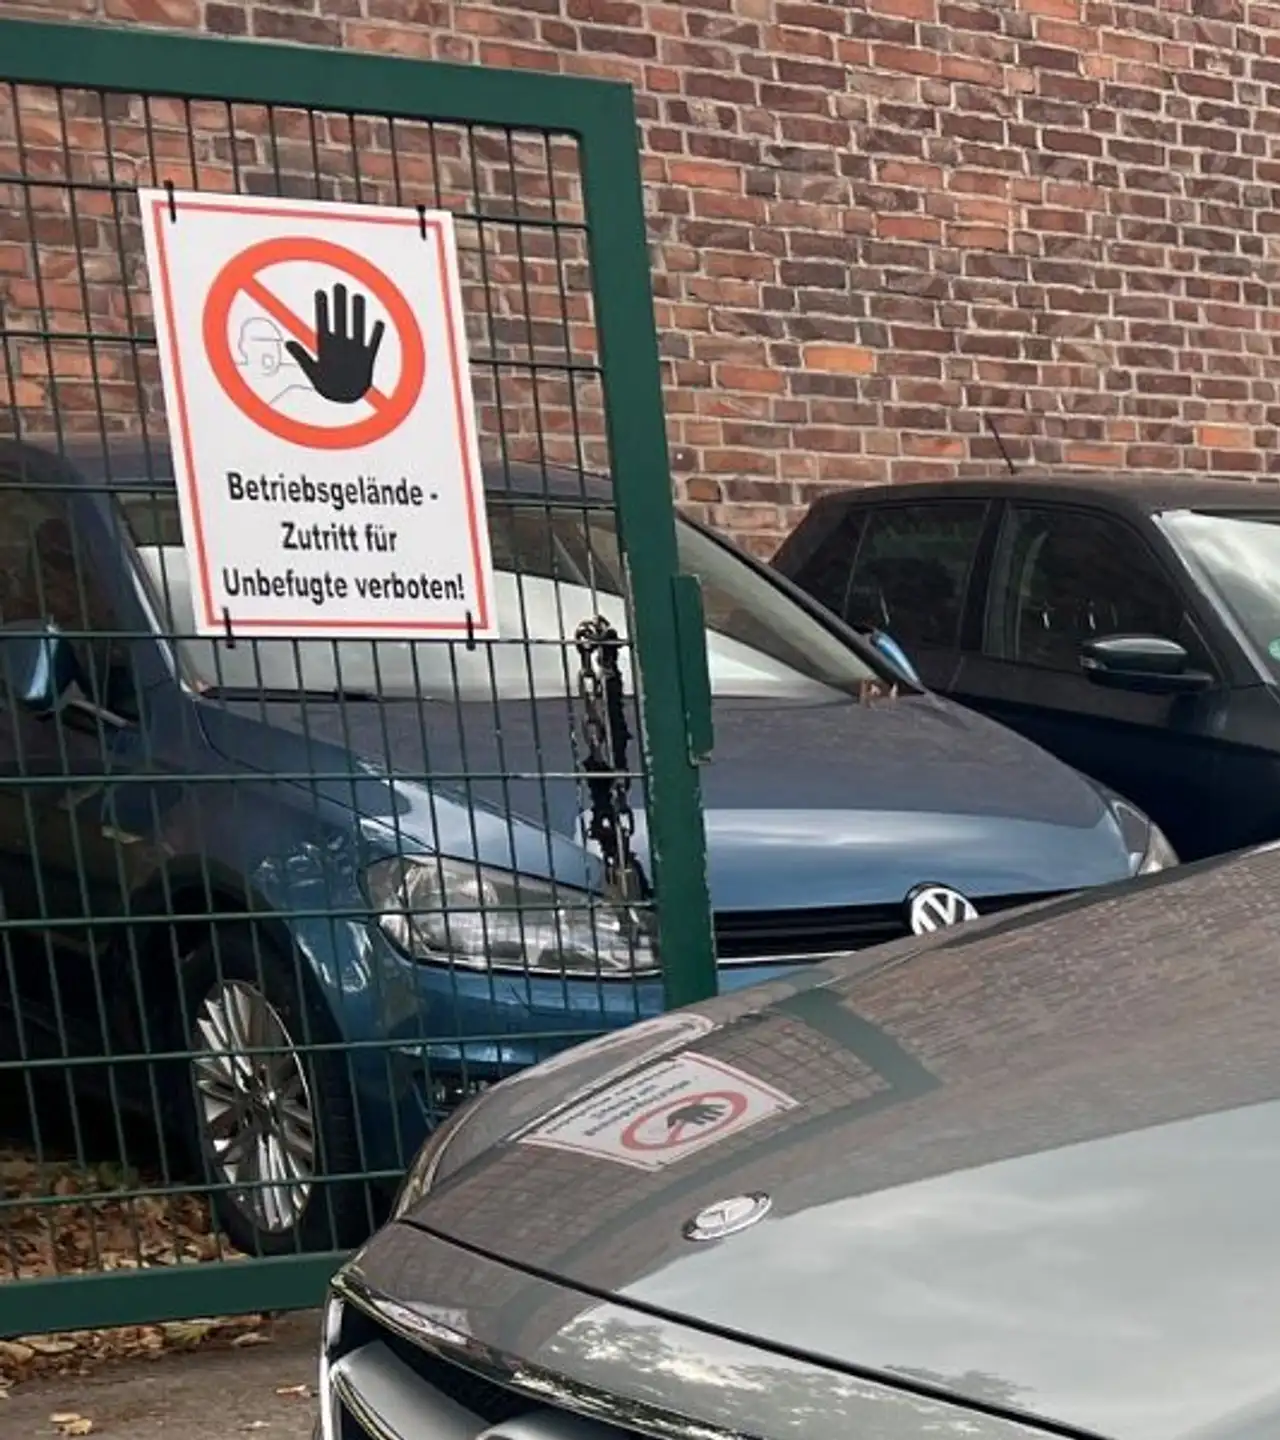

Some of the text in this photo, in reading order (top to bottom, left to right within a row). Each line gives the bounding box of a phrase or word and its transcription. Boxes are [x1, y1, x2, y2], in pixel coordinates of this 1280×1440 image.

[226, 472, 425, 510] Betriebsgelände
[280, 521, 398, 552] Zutritt für
[222, 567, 465, 606] Unbefugte verboten!
